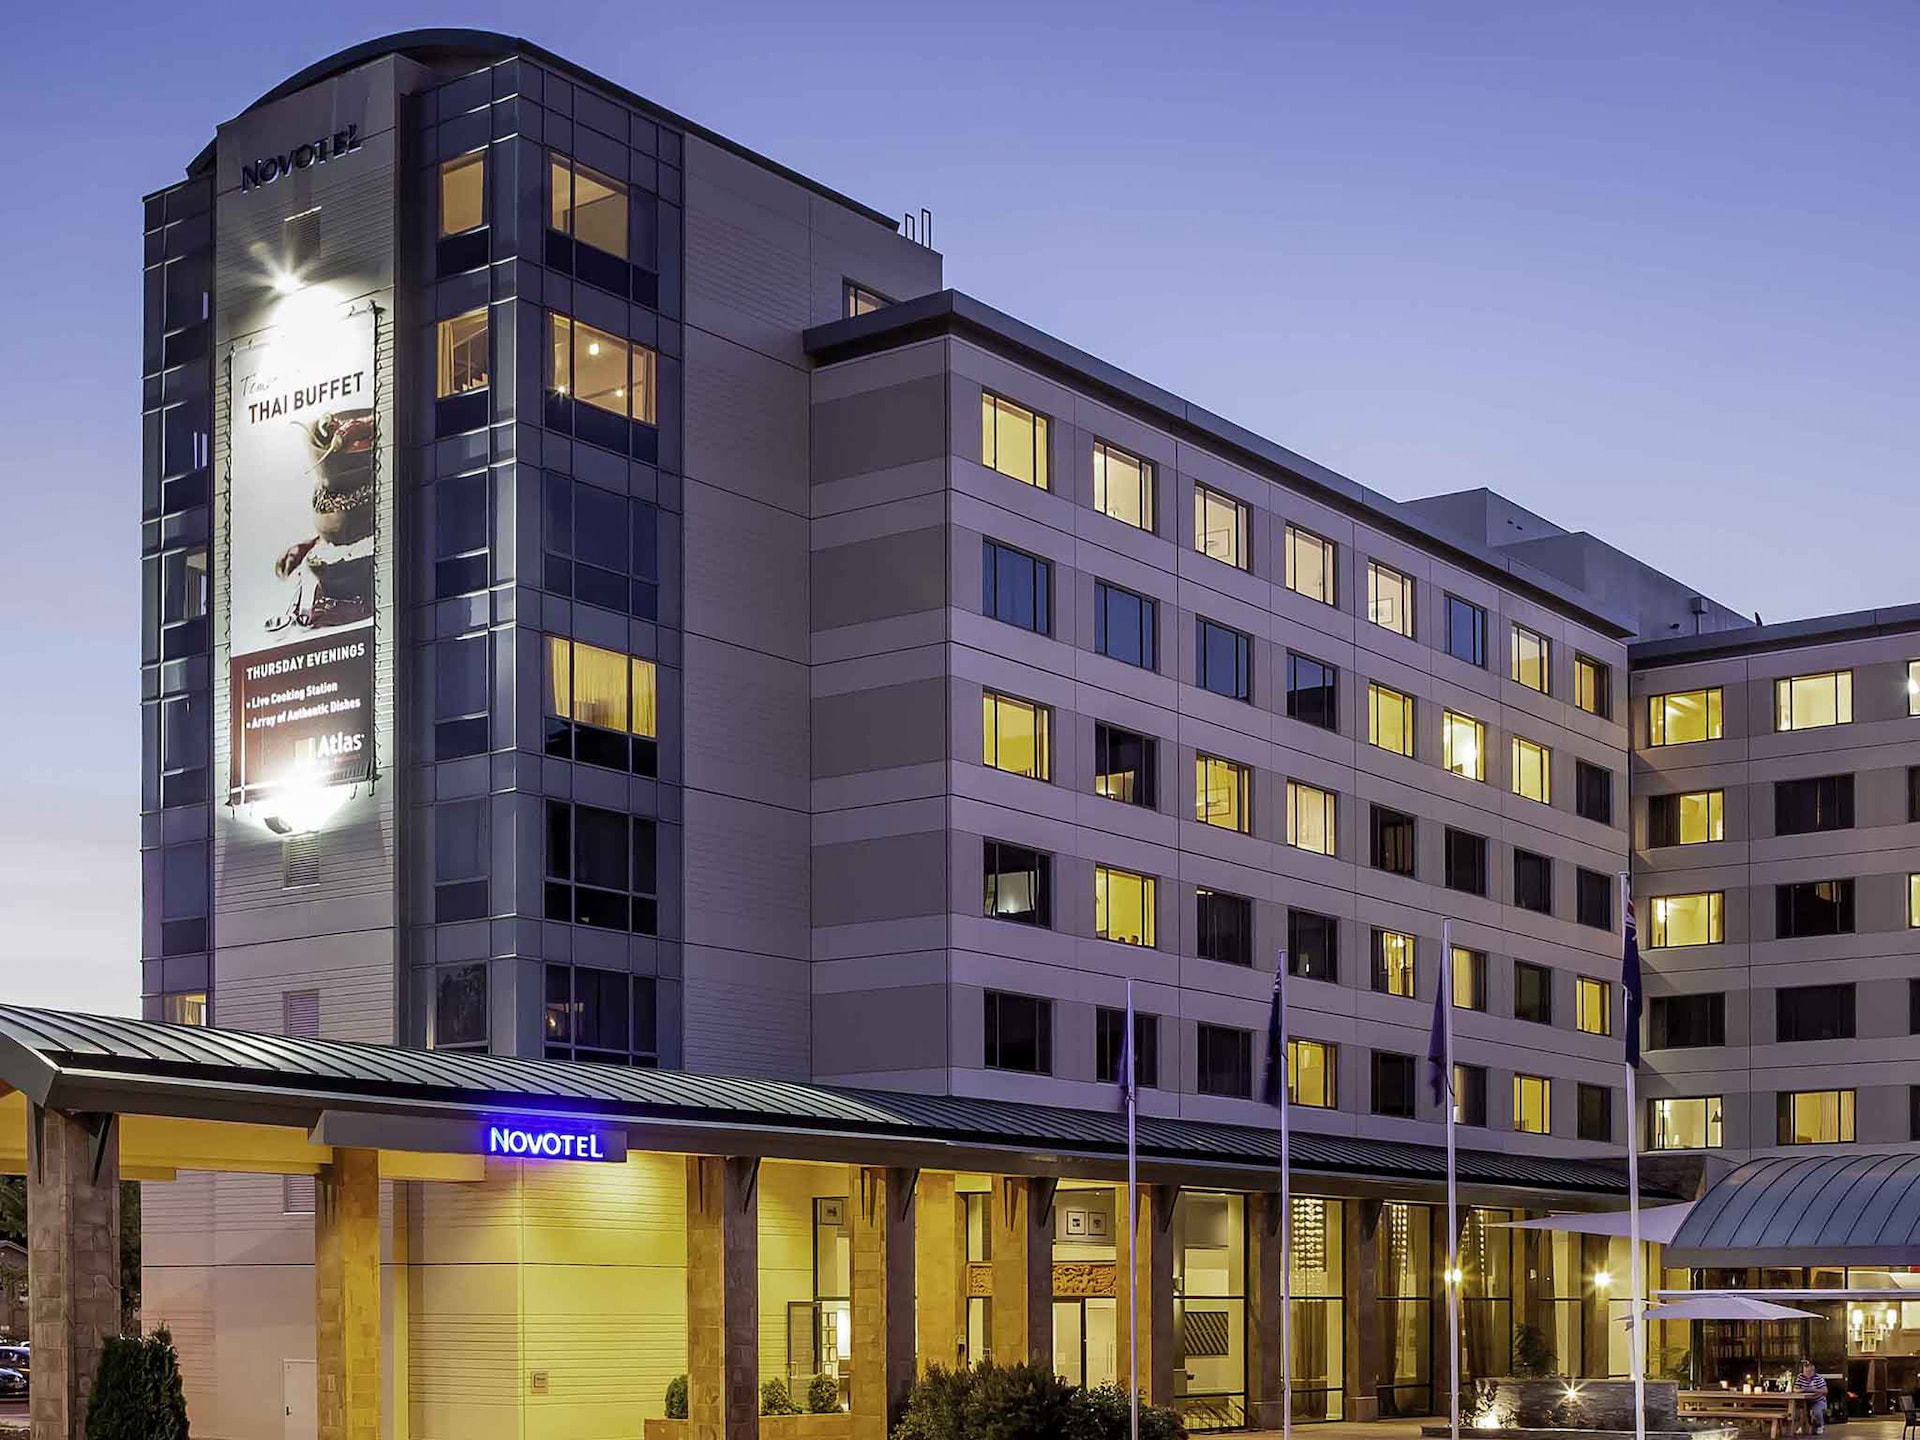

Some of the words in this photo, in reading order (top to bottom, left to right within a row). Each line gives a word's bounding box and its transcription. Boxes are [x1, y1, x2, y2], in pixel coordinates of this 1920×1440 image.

[240, 124, 362, 193] NOVOTEL
[248, 394, 288, 424] THAI
[294, 371, 364, 411] BUFFET
[246, 656, 304, 680] THURSDAY
[307, 642, 365, 667] EVENINGS
[252, 697, 270, 708] Live
[271, 688, 305, 704] Cooking
[306, 682, 338, 697] Station
[252, 714, 276, 729] Array
[277, 711, 287, 723] of
[287, 703, 329, 721] Authentic
[330, 698, 361, 713] Dishes
[317, 731, 362, 758] Atlas
[490, 1126, 604, 1158] NOVOTEL
